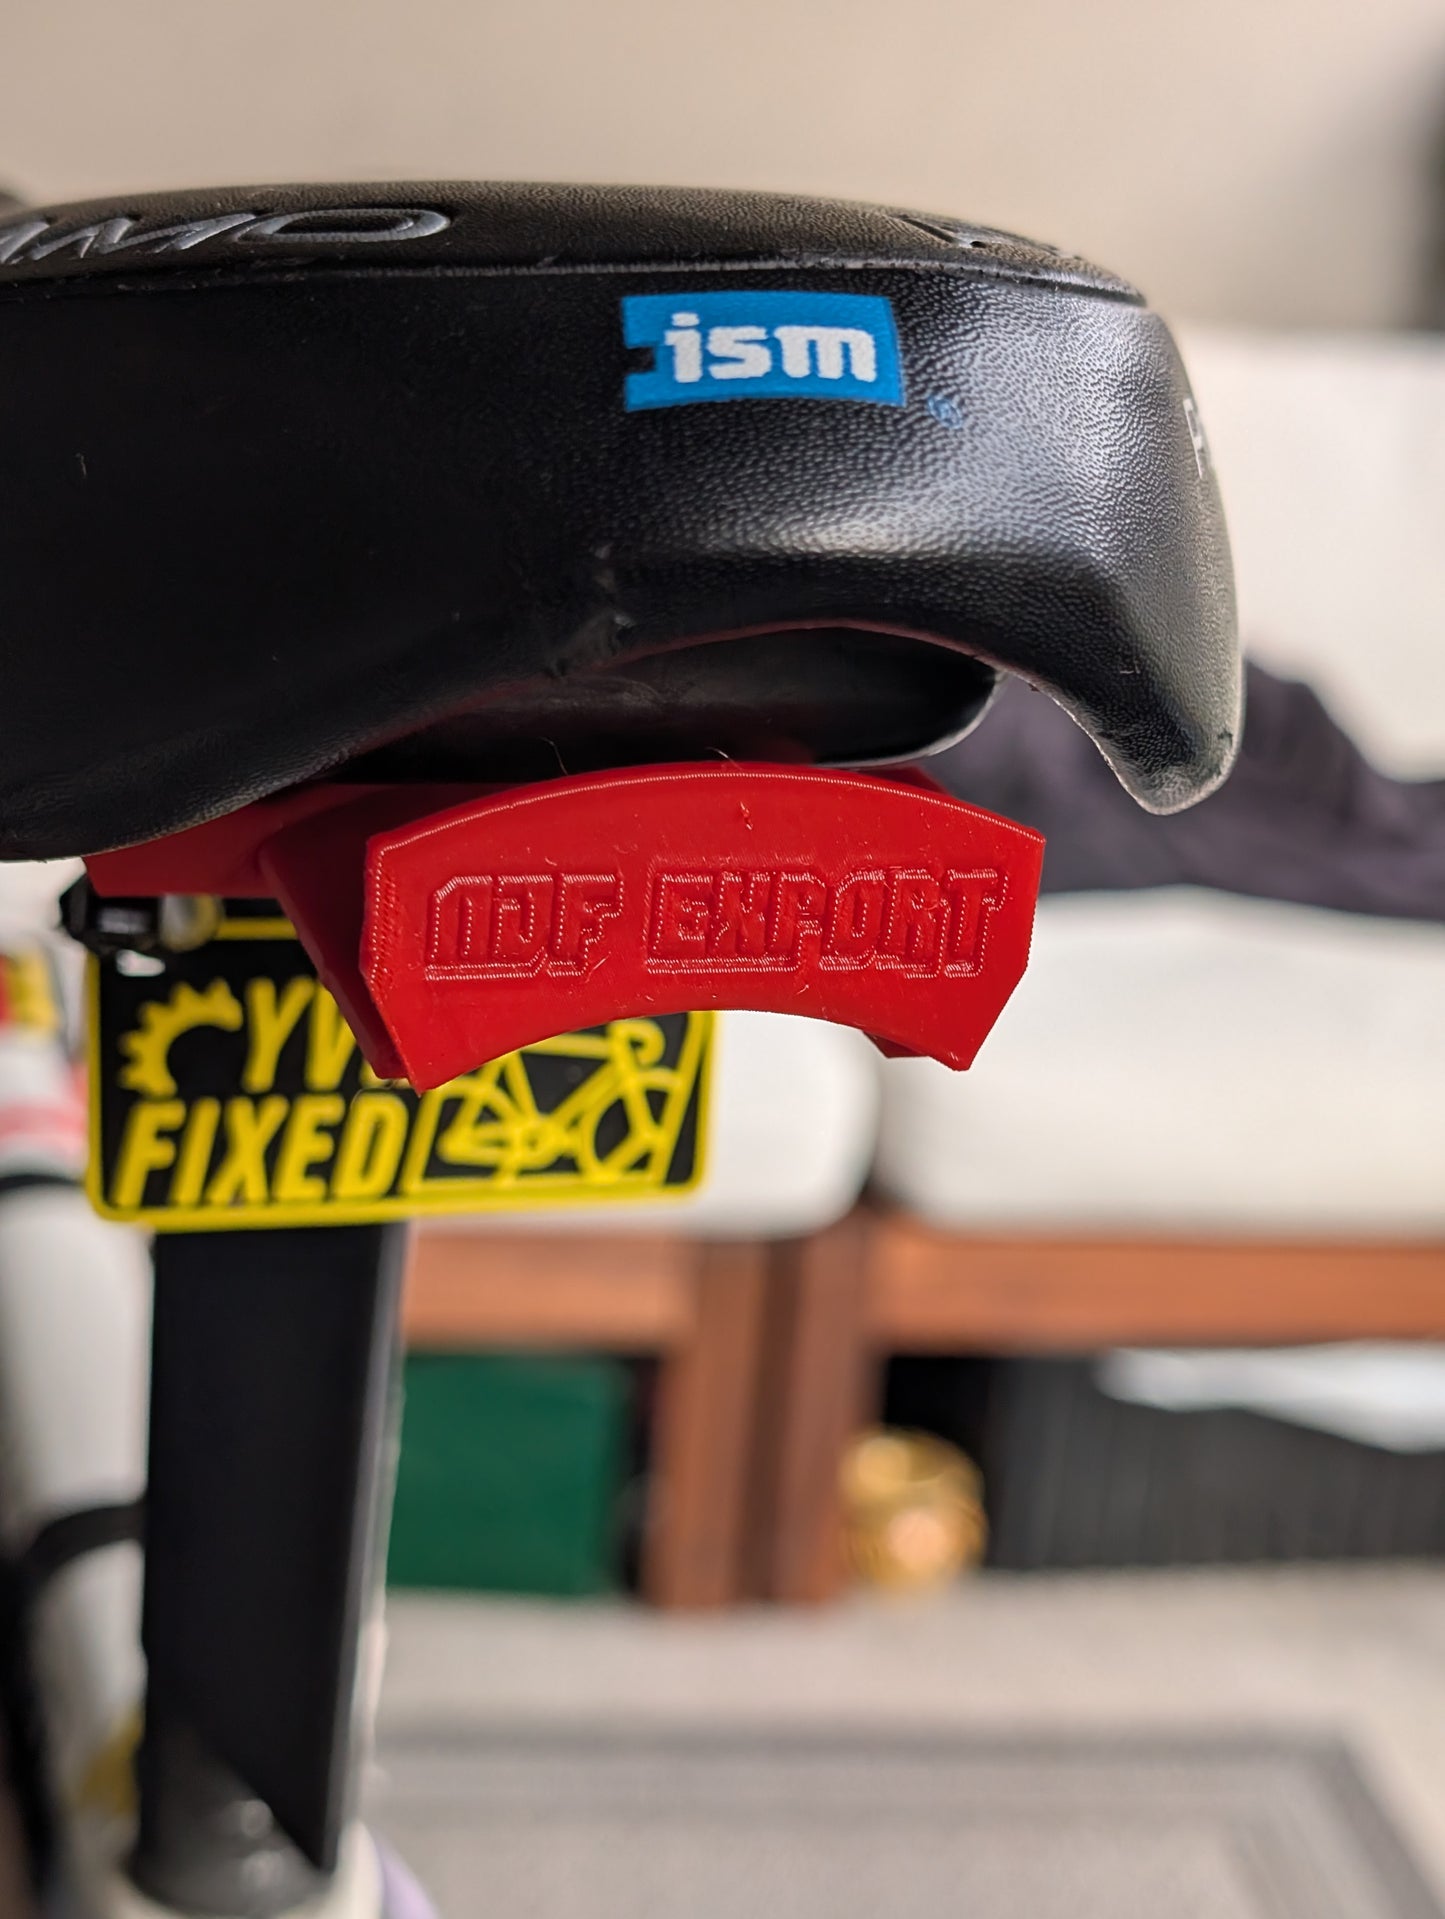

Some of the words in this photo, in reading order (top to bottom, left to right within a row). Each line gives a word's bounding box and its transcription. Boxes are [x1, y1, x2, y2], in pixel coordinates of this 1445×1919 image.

[665, 311, 877, 383] ism
[645, 867, 1008, 978] EXPORT
[109, 1093, 410, 1208] FIXED
